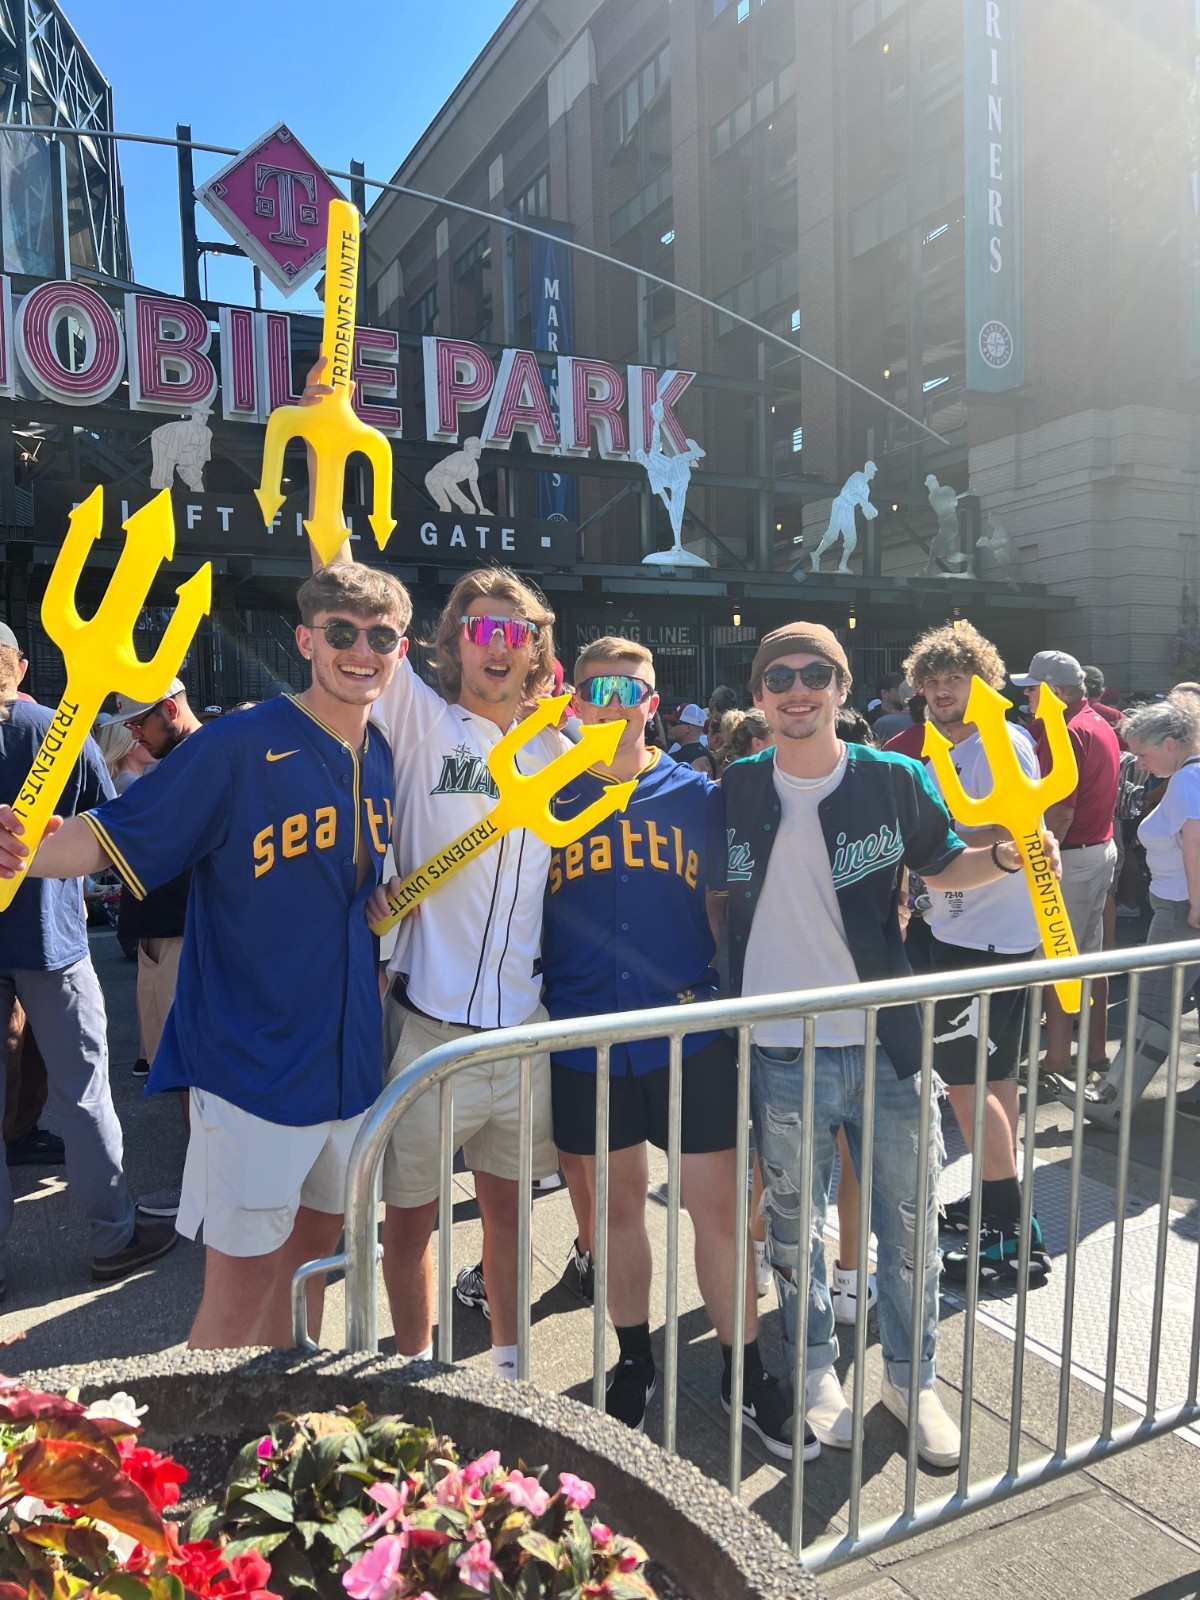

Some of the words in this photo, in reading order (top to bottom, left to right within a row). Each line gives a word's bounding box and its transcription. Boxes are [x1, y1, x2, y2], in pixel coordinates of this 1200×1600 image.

[340, 230, 358, 290] UNITE
[0, 274, 402, 438] OBILE
[422, 336, 698, 468] PARK
[332, 295, 354, 388] TRIDENTS
[420, 522, 516, 551] GATE
[647, 627, 690, 644] LINE
[19, 699, 80, 806] TRIDENTS
[427, 819, 499, 880] TRIDENTS
[1023, 829, 1061, 917] TRIDENTS
[1048, 920, 1073, 957] UNI
